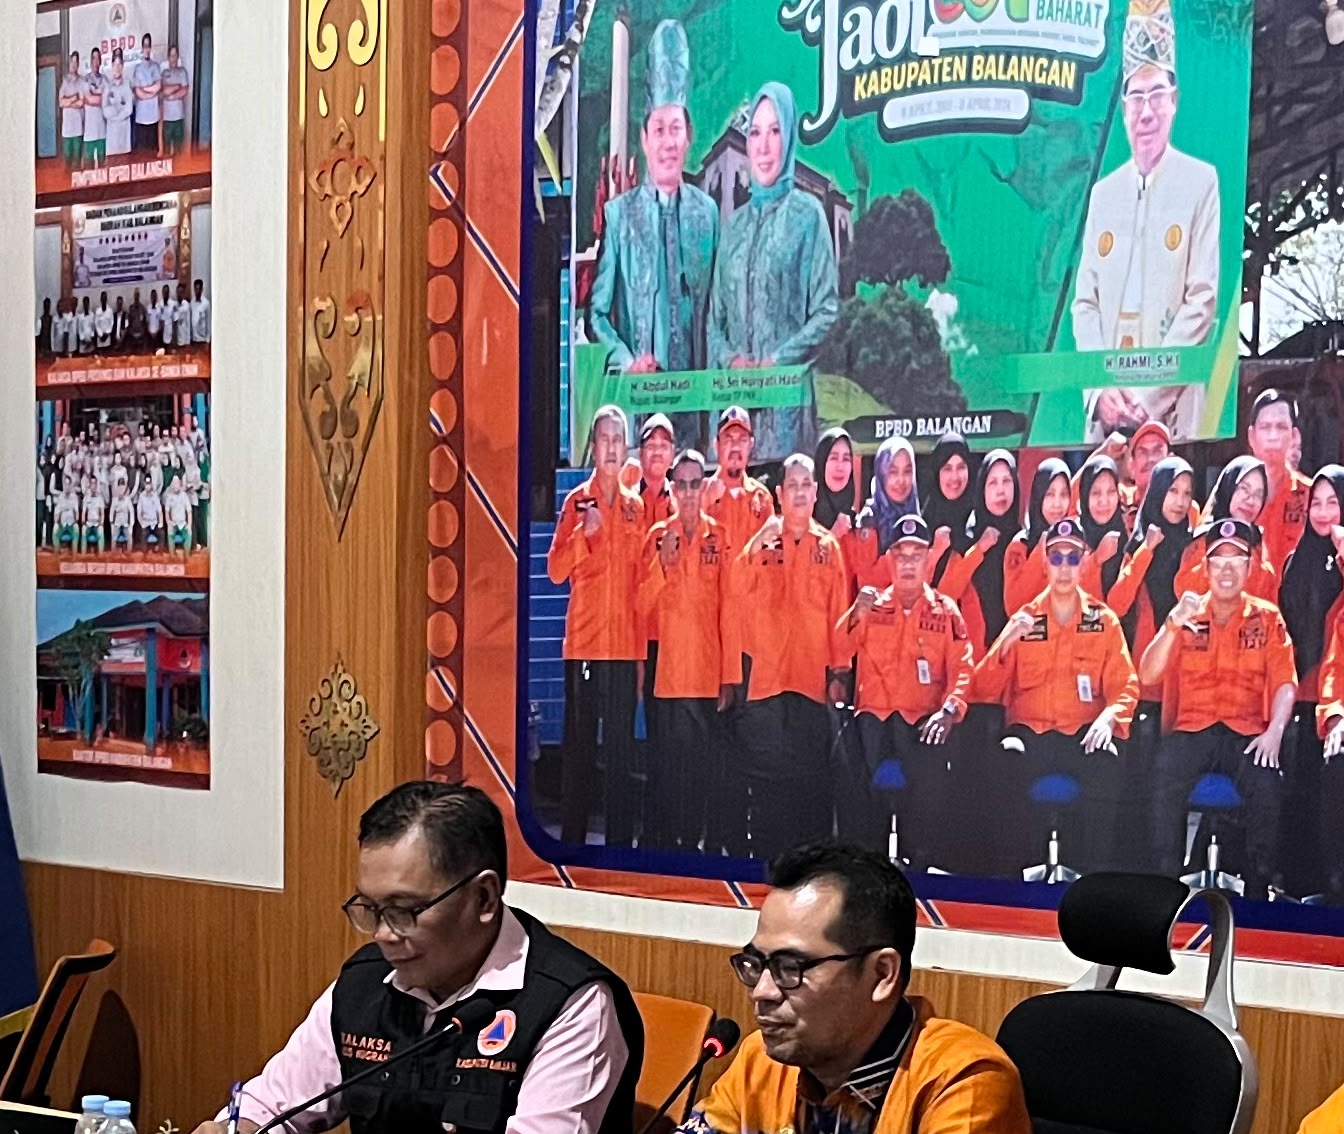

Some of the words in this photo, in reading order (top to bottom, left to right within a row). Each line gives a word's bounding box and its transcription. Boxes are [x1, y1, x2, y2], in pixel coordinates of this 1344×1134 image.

[1035, 0, 1104, 29] BAHARAT
[853, 54, 967, 101] KABUPATEN
[971, 54, 1077, 90] BALANGAN
[875, 418, 913, 438] BPBD
[915, 415, 992, 437] BALANGAN
